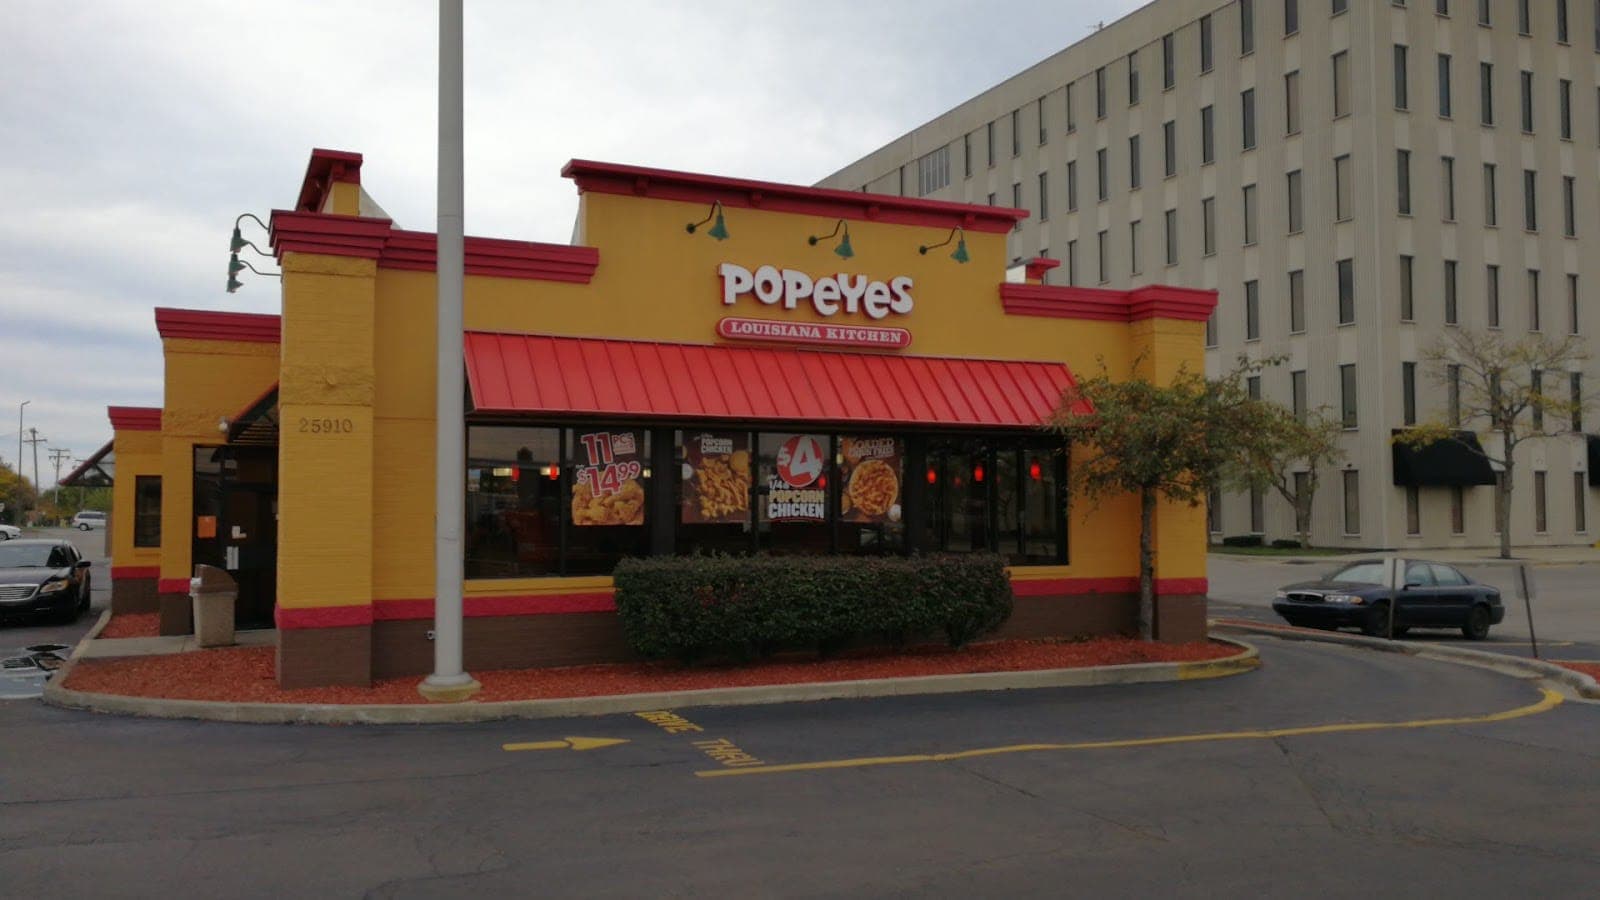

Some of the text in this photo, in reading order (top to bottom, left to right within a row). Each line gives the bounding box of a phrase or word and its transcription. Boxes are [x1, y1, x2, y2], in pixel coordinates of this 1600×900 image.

[730, 321, 902, 343] LOUISIANA KITCHEN
[298, 417, 353, 433] 25910
[580, 431, 614, 466] 11
[776, 435, 824, 479] $4
[768, 489, 825, 503] POPCORN
[768, 503, 825, 519] CHICKEN
[633, 710, 705, 734] DRIVE
[690, 737, 766, 767] THRU
